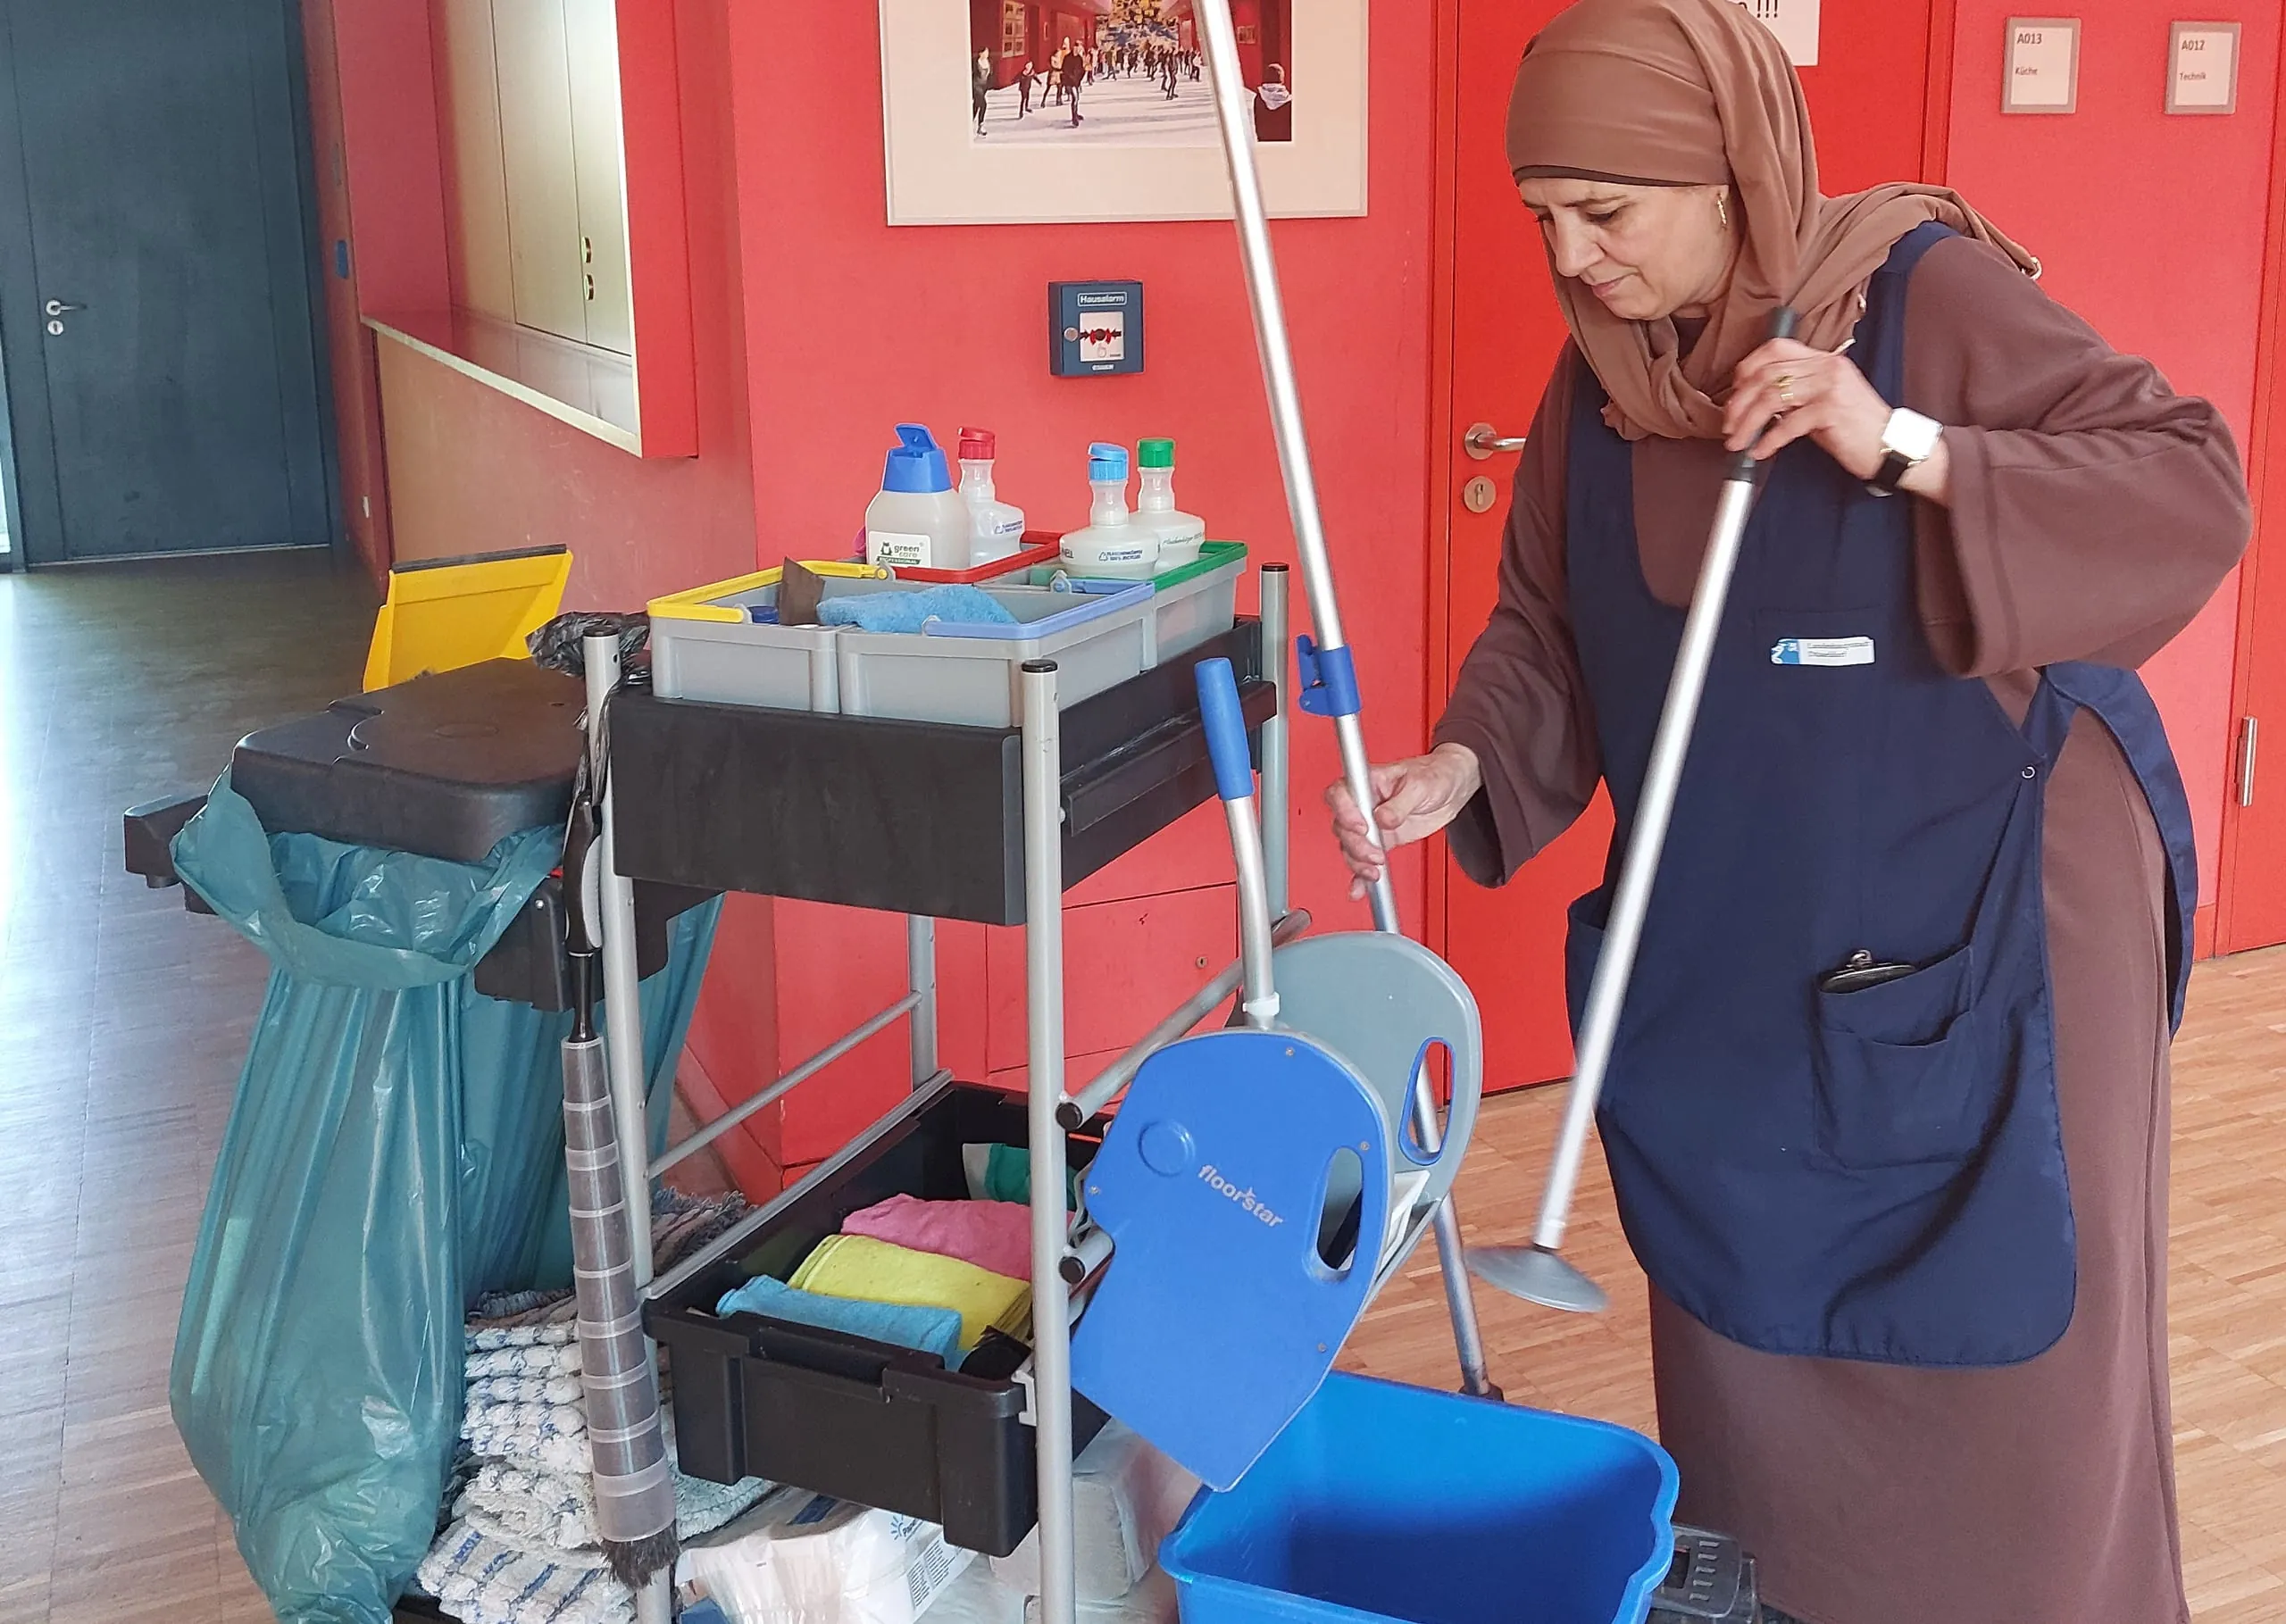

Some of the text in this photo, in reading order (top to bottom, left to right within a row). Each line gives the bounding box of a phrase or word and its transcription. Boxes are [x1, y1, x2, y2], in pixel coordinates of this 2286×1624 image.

[2016, 33, 2042, 45] A013
[2179, 71, 2206, 81] Technik
[1080, 295, 1125, 304] Hausalarm
[894, 545, 920, 554] green
[1197, 1163, 1284, 1228] floorstar
